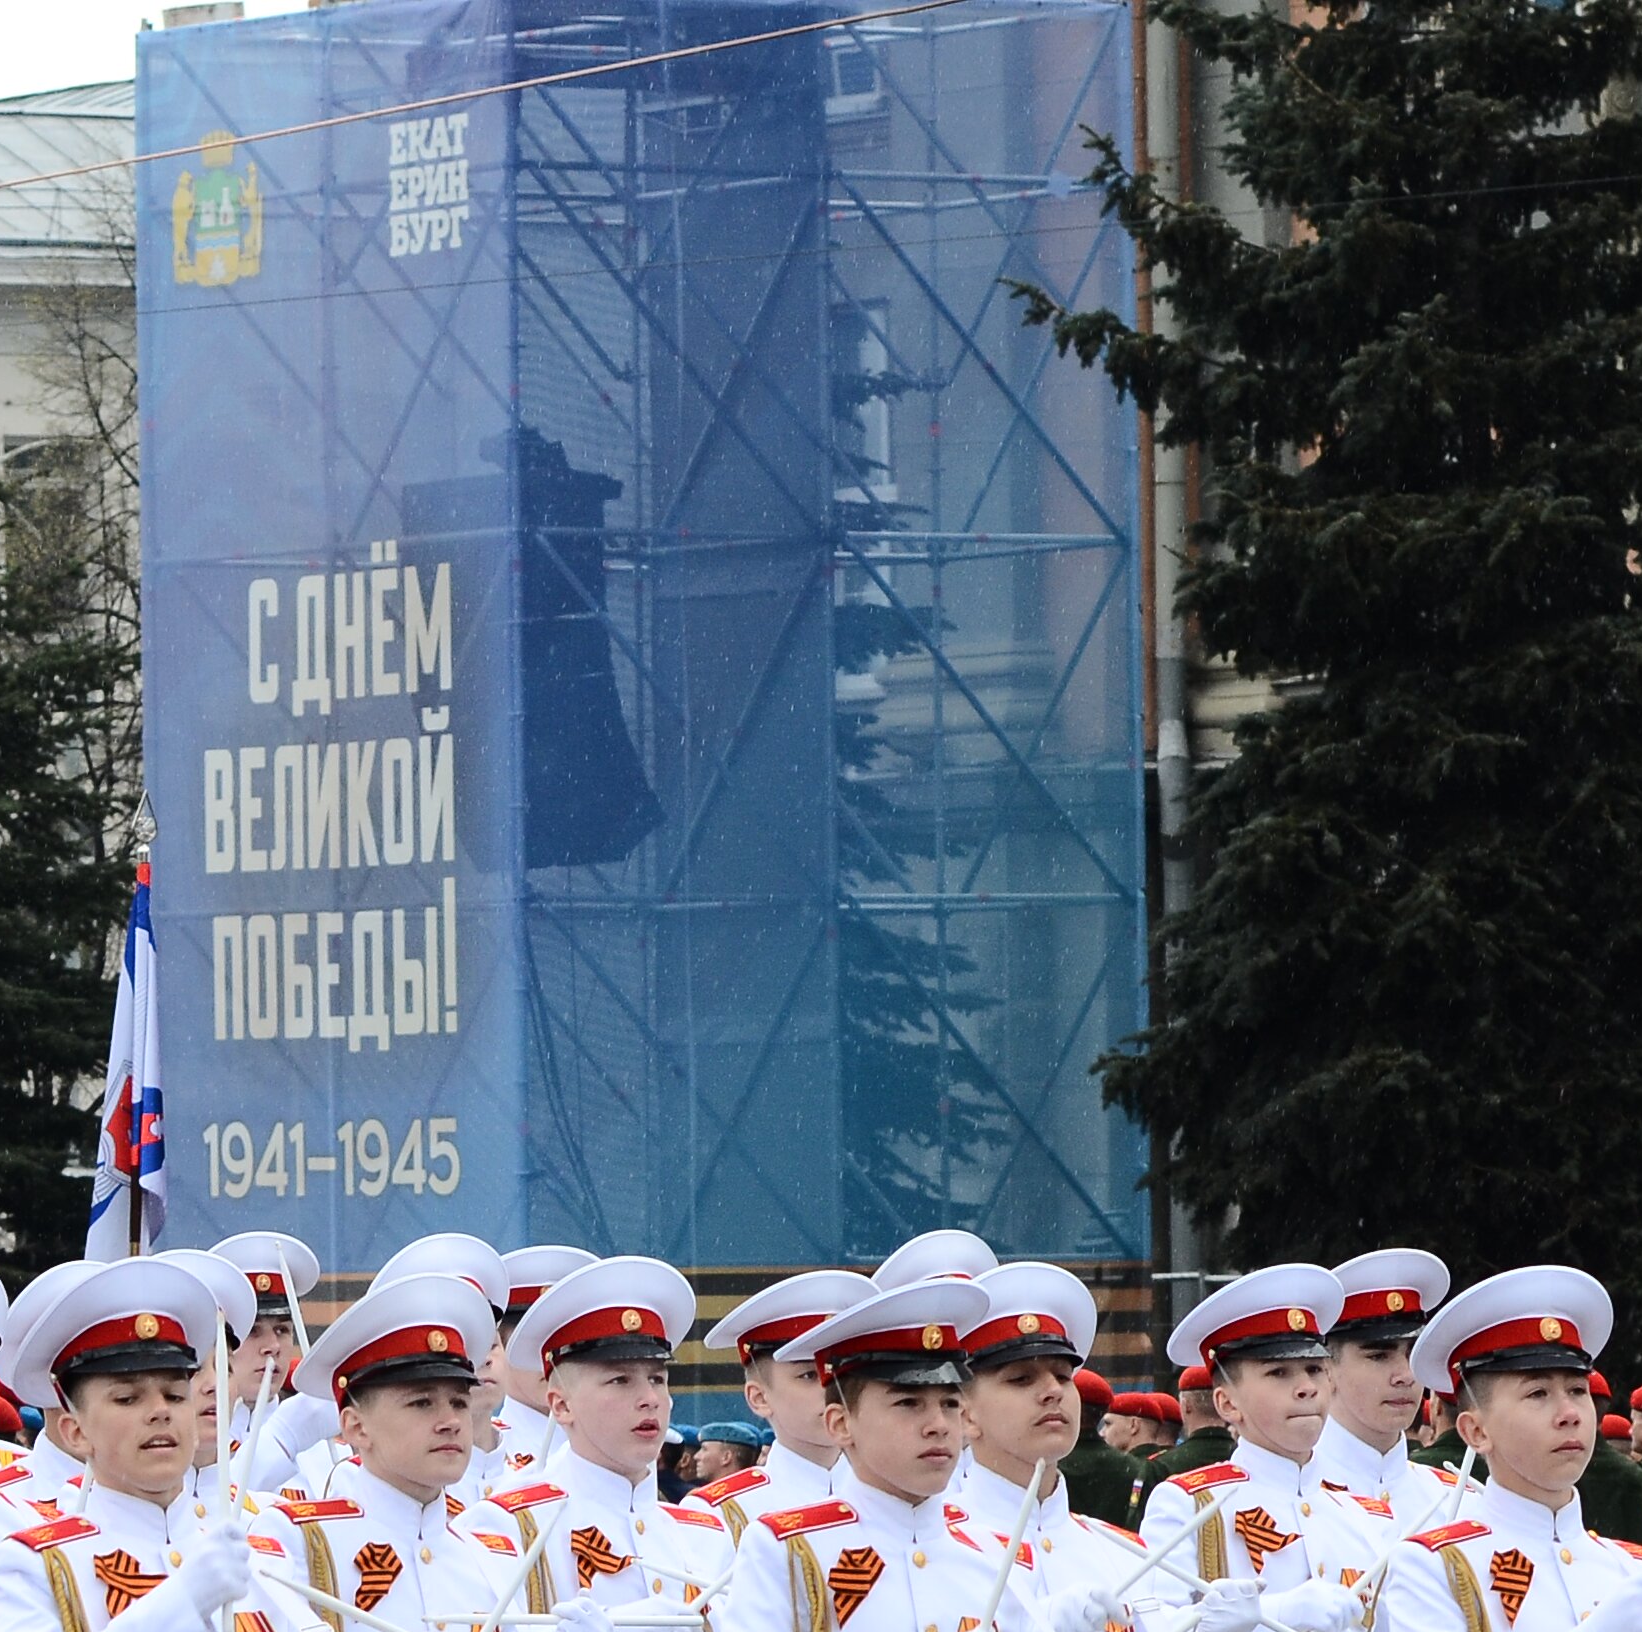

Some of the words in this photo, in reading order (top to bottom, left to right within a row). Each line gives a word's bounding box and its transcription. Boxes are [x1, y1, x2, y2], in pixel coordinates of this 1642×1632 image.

[390, 113, 469, 165] ЕКАТ
[390, 159, 469, 211] ЕРИН
[390, 205, 469, 257] БУРГ
[248, 578, 279, 703] С
[292, 540, 452, 717] ДНЁМ
[204, 706, 455, 874] ВЕЛИКОЙ
[213, 877, 457, 1052] ПОБЕДЫ!
